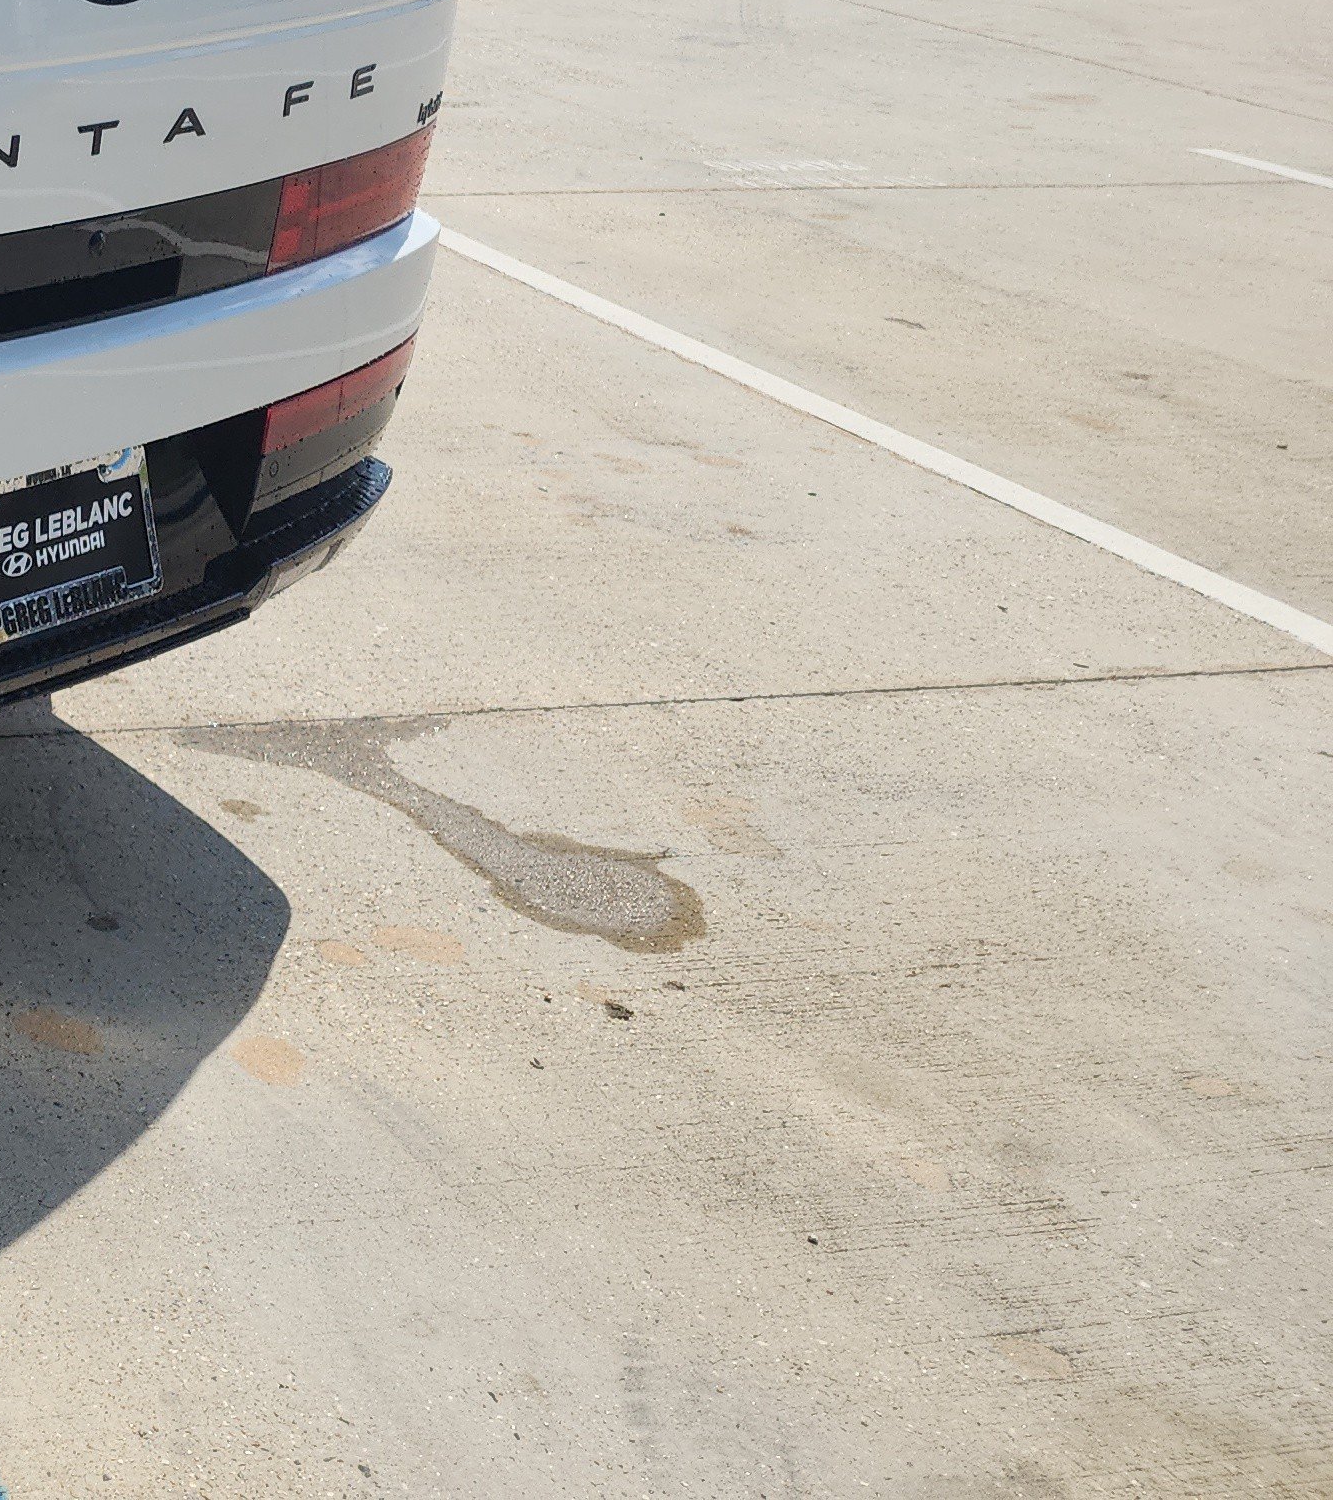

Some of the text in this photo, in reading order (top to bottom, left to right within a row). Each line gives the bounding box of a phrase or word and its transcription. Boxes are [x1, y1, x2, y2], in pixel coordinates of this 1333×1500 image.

[282, 62, 378, 119] FE
[35, 491, 134, 544] LEBLANC
[35, 529, 106, 567] HYUNDAI
[1, 594, 53, 637] GREG
